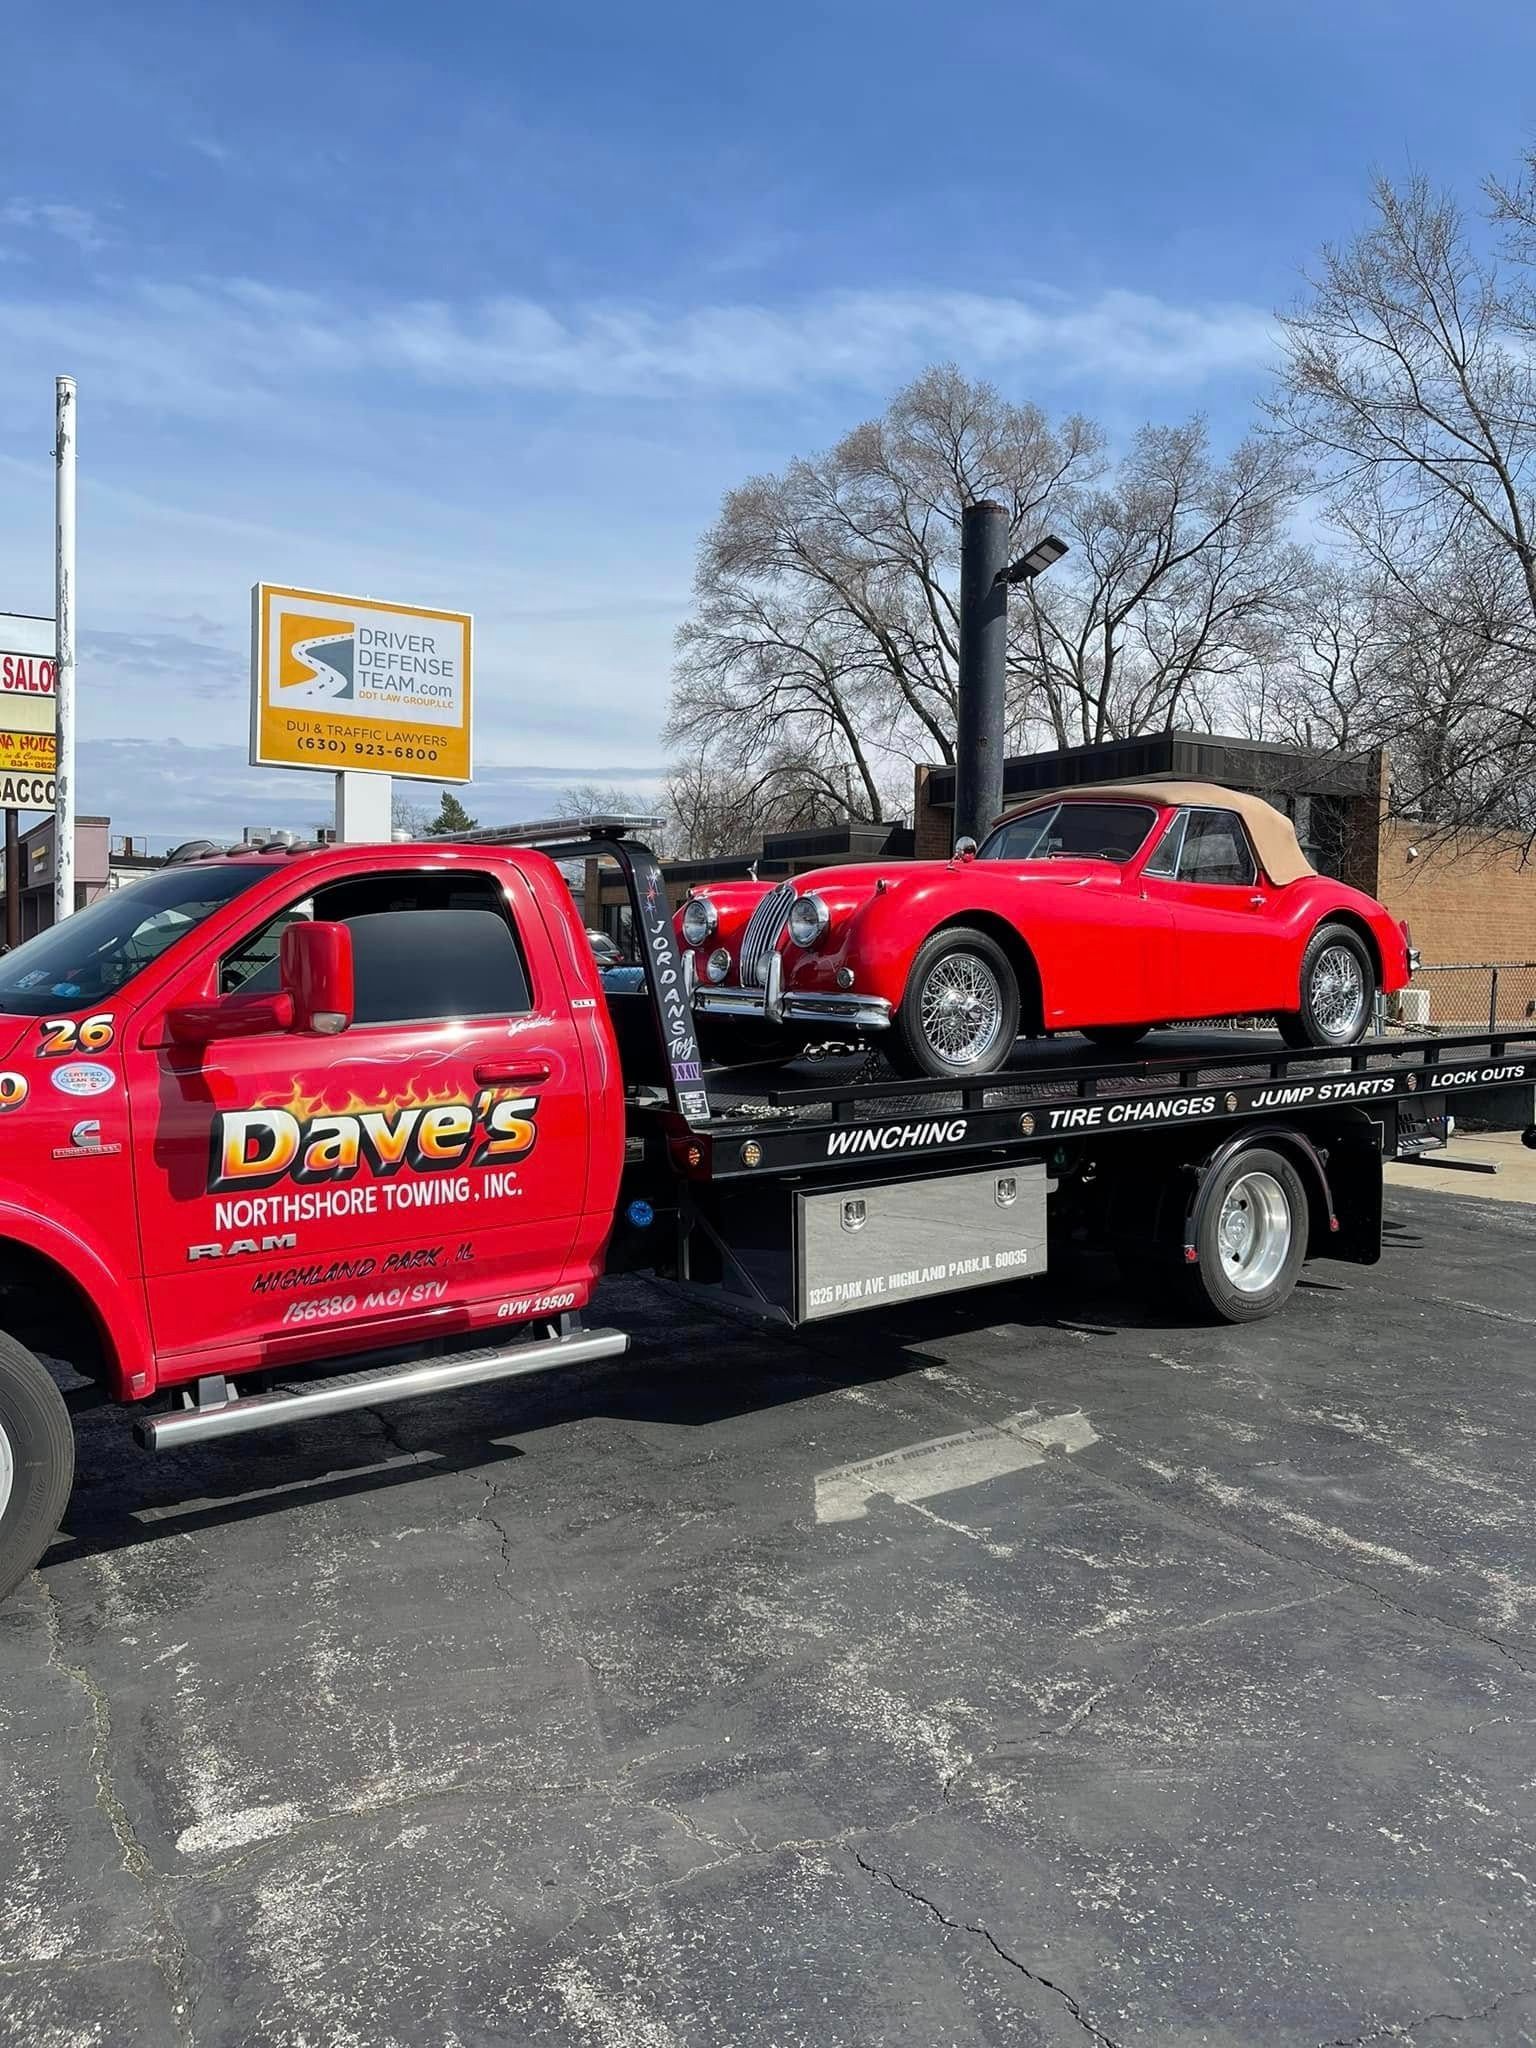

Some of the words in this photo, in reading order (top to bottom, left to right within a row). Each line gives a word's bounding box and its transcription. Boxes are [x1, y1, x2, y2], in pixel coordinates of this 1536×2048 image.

[360, 628, 435, 654] DRIVER
[359, 649, 454, 677] DEFENSE
[358, 670, 452, 698] TEAM.com
[359, 690, 380, 700] DDT
[381, 693, 400, 702] LAW
[287, 720, 309, 732] DUI
[313, 724, 322, 734] &
[327, 725, 381, 740] TRAFFIC
[386, 731, 448, 747] LAWYERS
[297, 737, 346, 753] (630)
[355, 743, 437, 761] 923-6800
[0, 777, 56, 804] ACCO
[36, 1012, 115, 1058] 26
[667, 1036, 697, 1060] Toy
[671, 1061, 702, 1081] XXIV
[1431, 1070, 1478, 1088] LOCK
[1481, 1065, 1526, 1081] OUTS
[1251, 1086, 1315, 1108] JUMP
[1317, 1078, 1396, 1100] STARTS
[1049, 1106, 1103, 1128] TIRE
[1107, 1096, 1215, 1123] CHANGES
[208, 1091, 540, 1193] Dave's
[826, 1119, 968, 1155] WINCHING
[215, 1186, 378, 1231] NORTHSHORE
[484, 1171, 523, 1200] INC.
[188, 1233, 297, 1260] RAM
[252, 1257, 376, 1293] HIGHLAND
[455, 1242, 475, 1261] IL
[809, 1286, 833, 1306] 1325
[835, 1280, 863, 1301] PARK
[888, 1264, 946, 1290] HIGHLAND
[995, 1248, 1028, 1269] 60035
[282, 1294, 356, 1325] 156380
[497, 1299, 533, 1317] GVW
[531, 1292, 575, 1313] 19500
